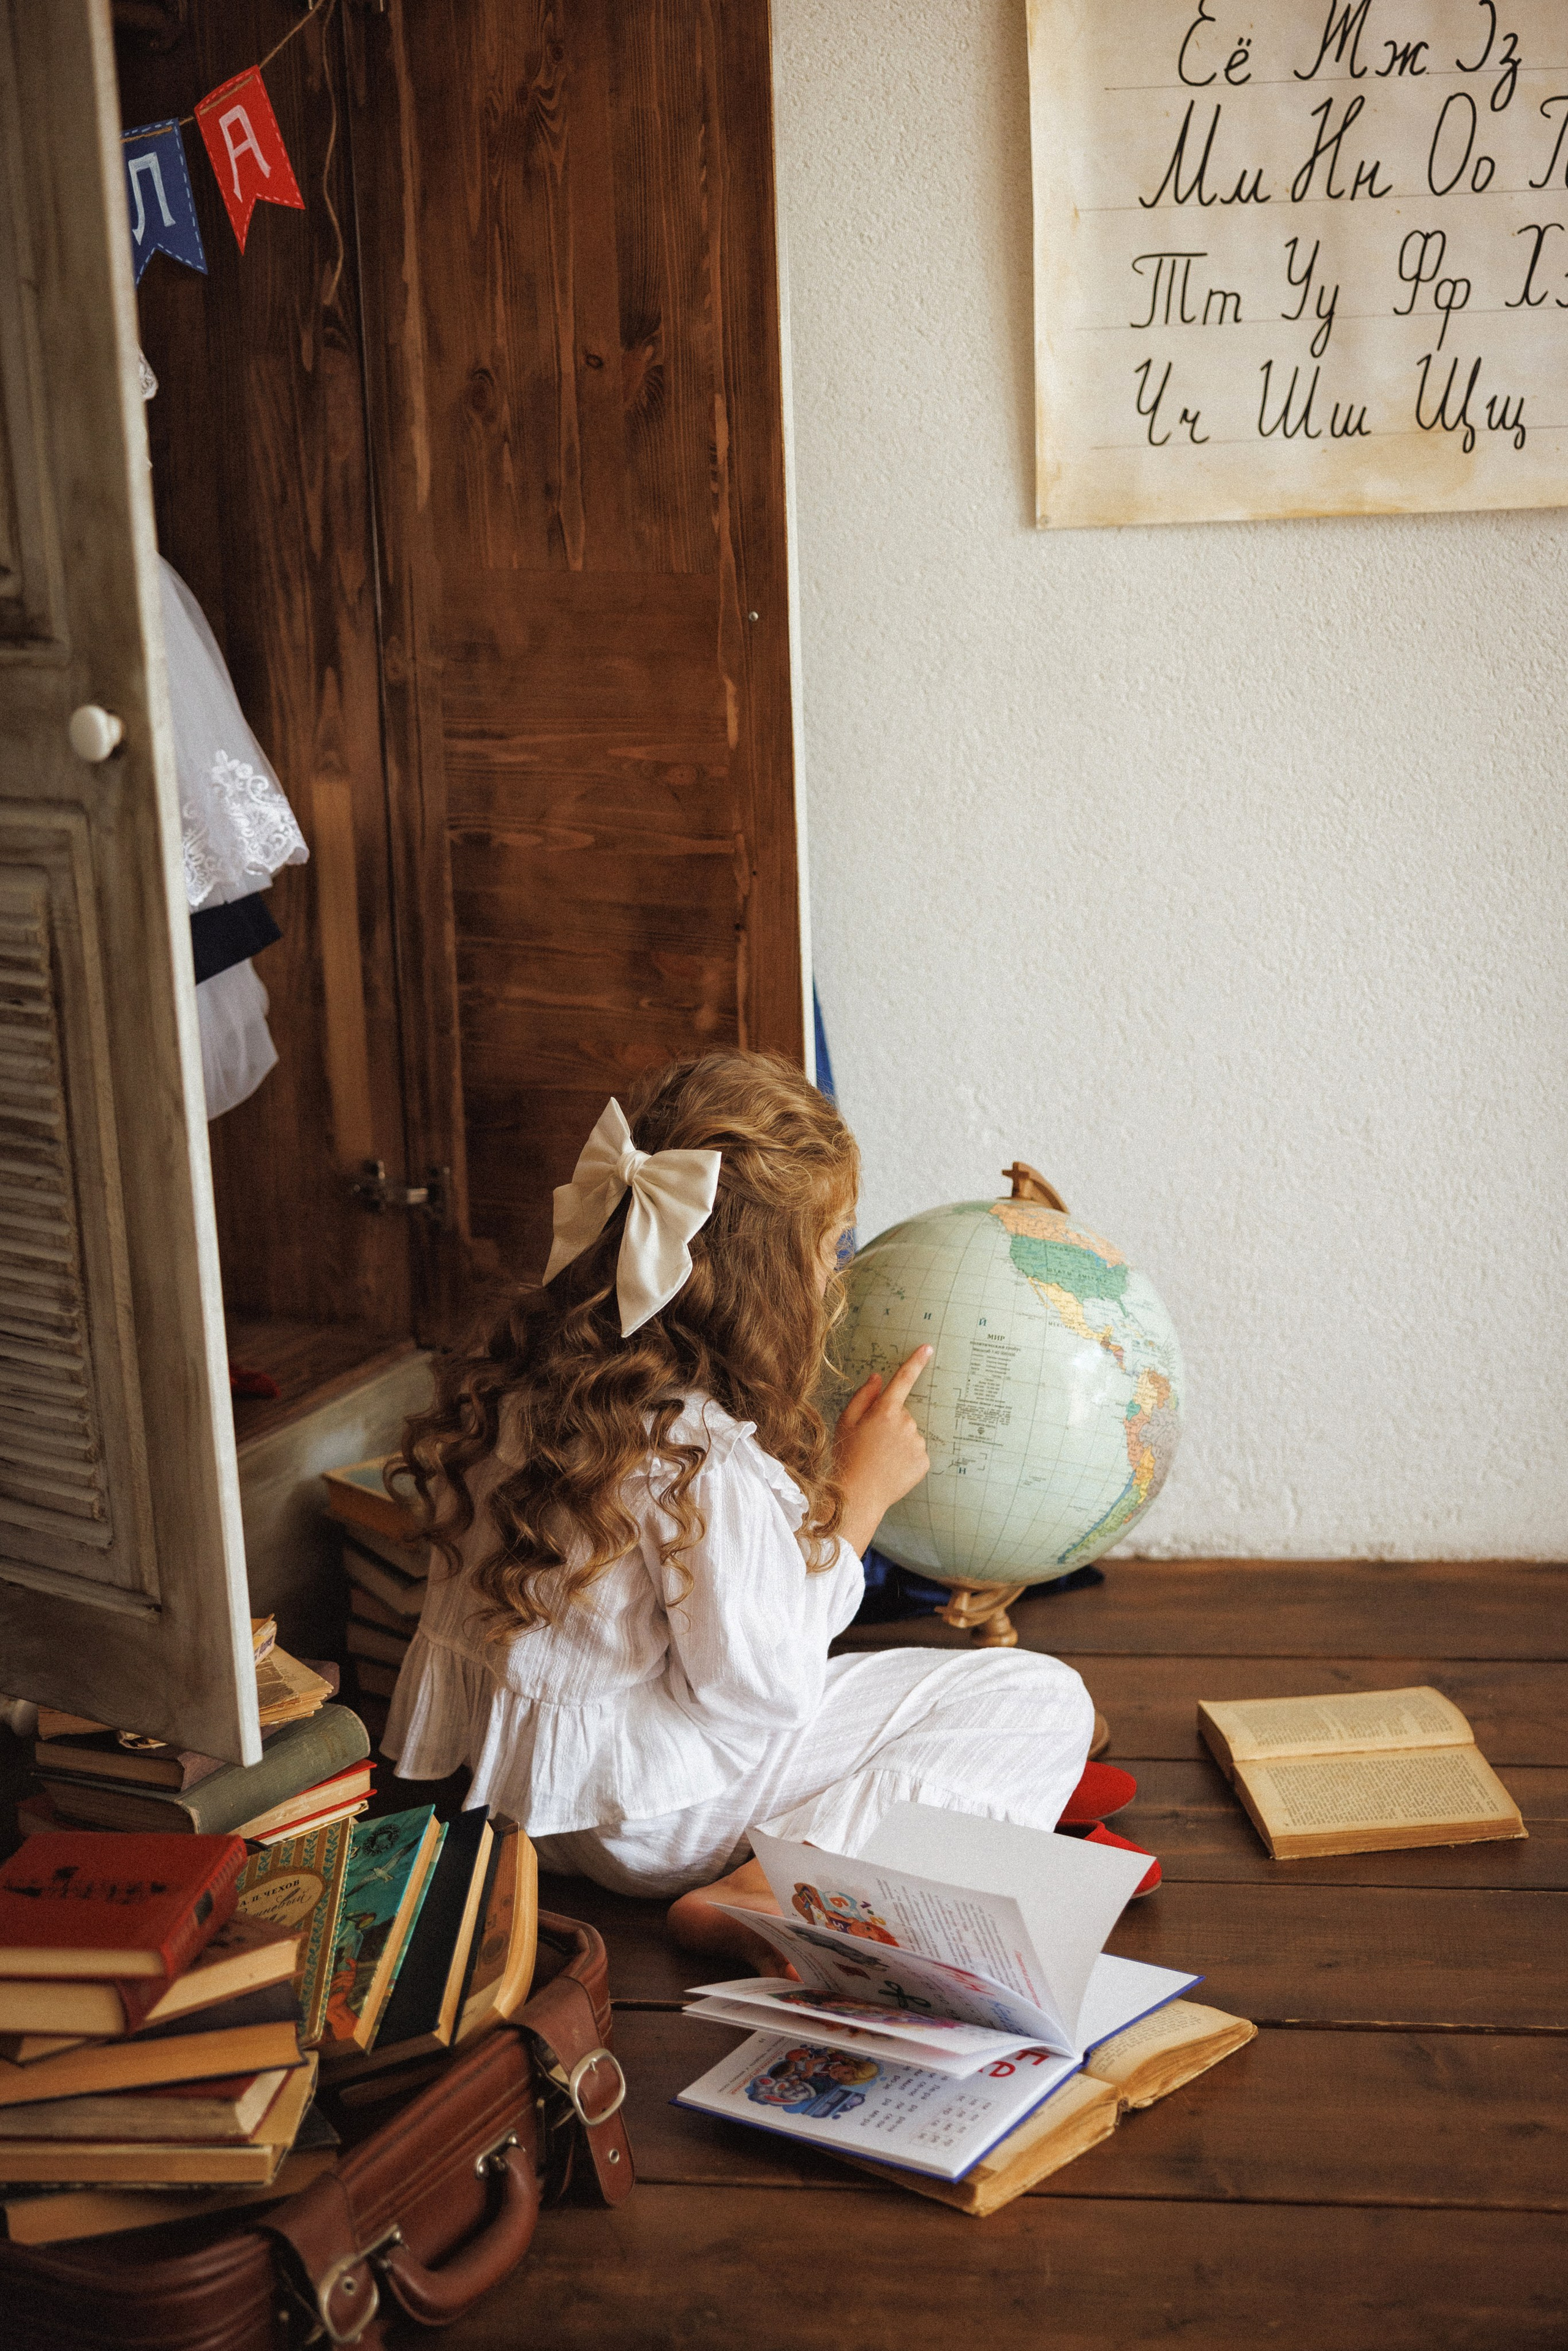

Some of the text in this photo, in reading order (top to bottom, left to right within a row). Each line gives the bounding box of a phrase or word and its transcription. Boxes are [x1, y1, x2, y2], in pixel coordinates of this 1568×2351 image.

[1139, 100, 1270, 208] Мм
[1292, 96, 1392, 202] Нн
[1428, 92, 1494, 196] Оо
[1131, 253, 1242, 328] Тт
[1281, 237, 1339, 358] Уу
[1393, 230, 1471, 350] Фф
[1135, 353, 1526, 453] Чч Шш Щщ
[263, 1879, 300, 1897] ЧЕХОВ
